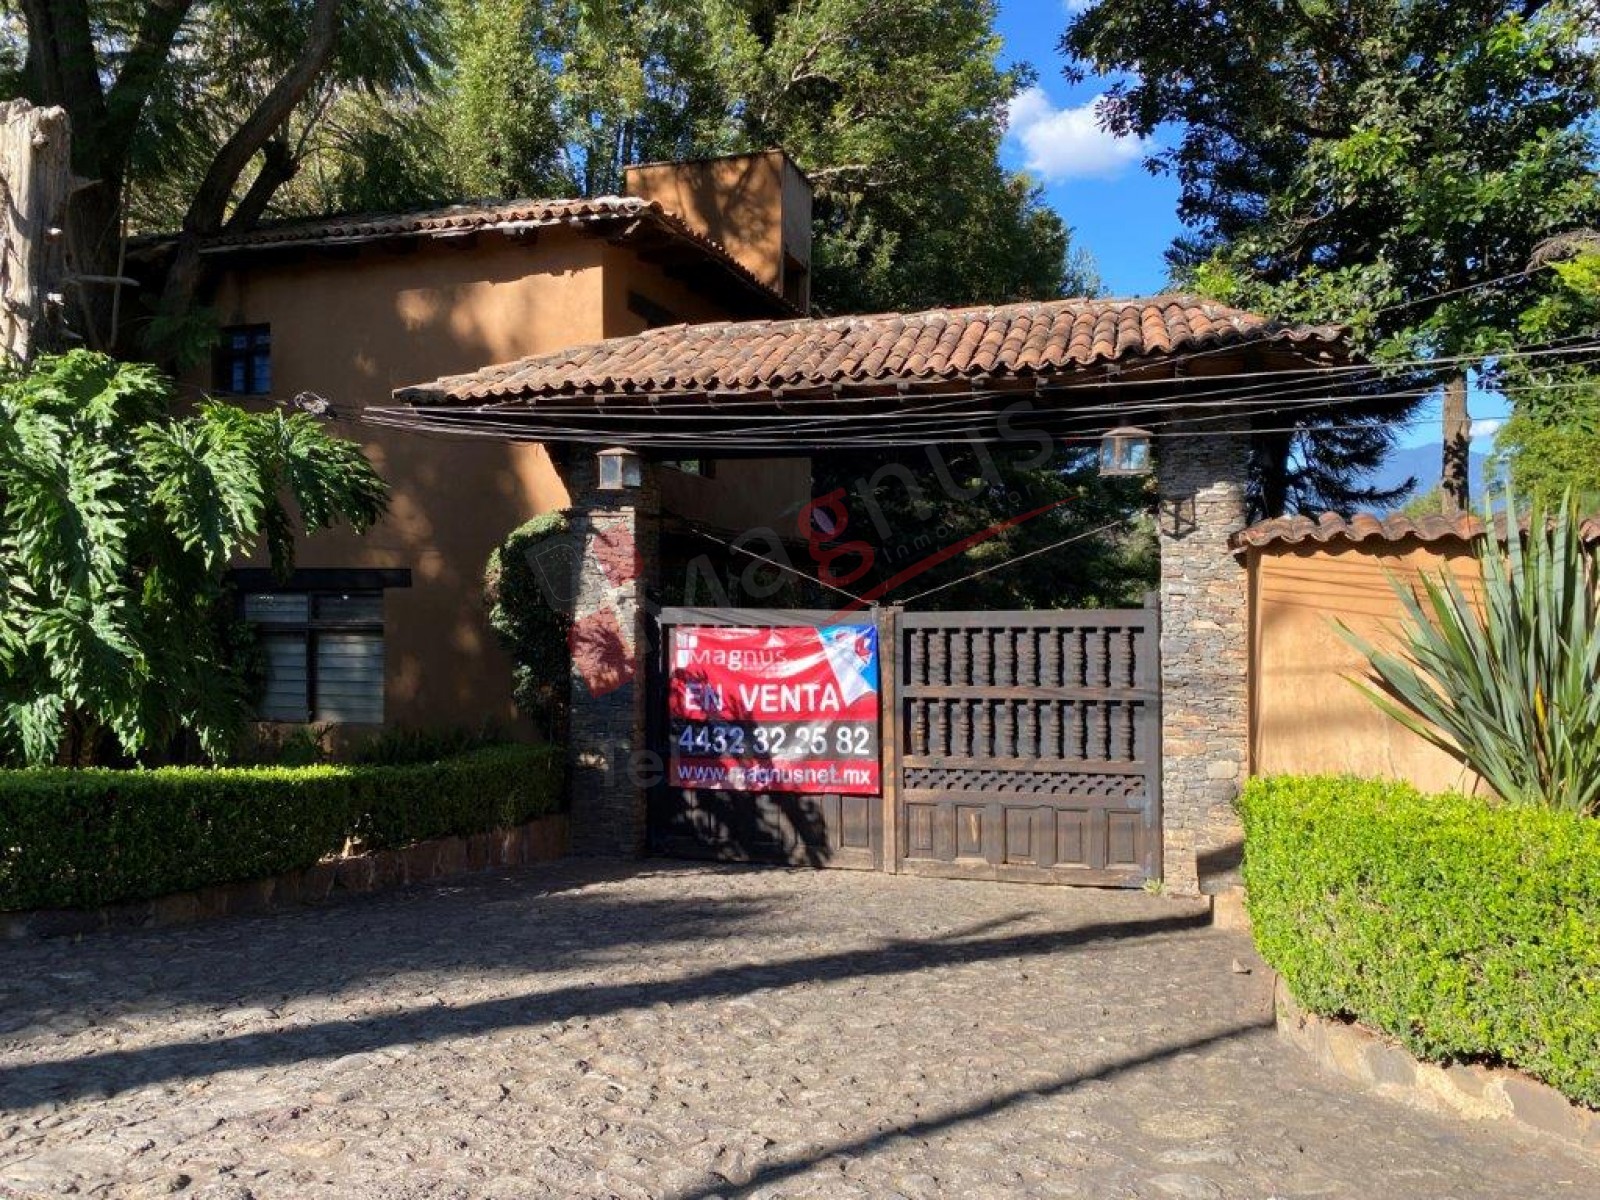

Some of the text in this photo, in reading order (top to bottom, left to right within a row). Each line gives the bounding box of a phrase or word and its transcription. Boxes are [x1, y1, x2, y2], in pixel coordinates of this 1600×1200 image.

[688, 648, 787, 671] Magnus
[684, 682, 840, 712] EN VENTA
[678, 724, 870, 755] 4432 32 25 82
